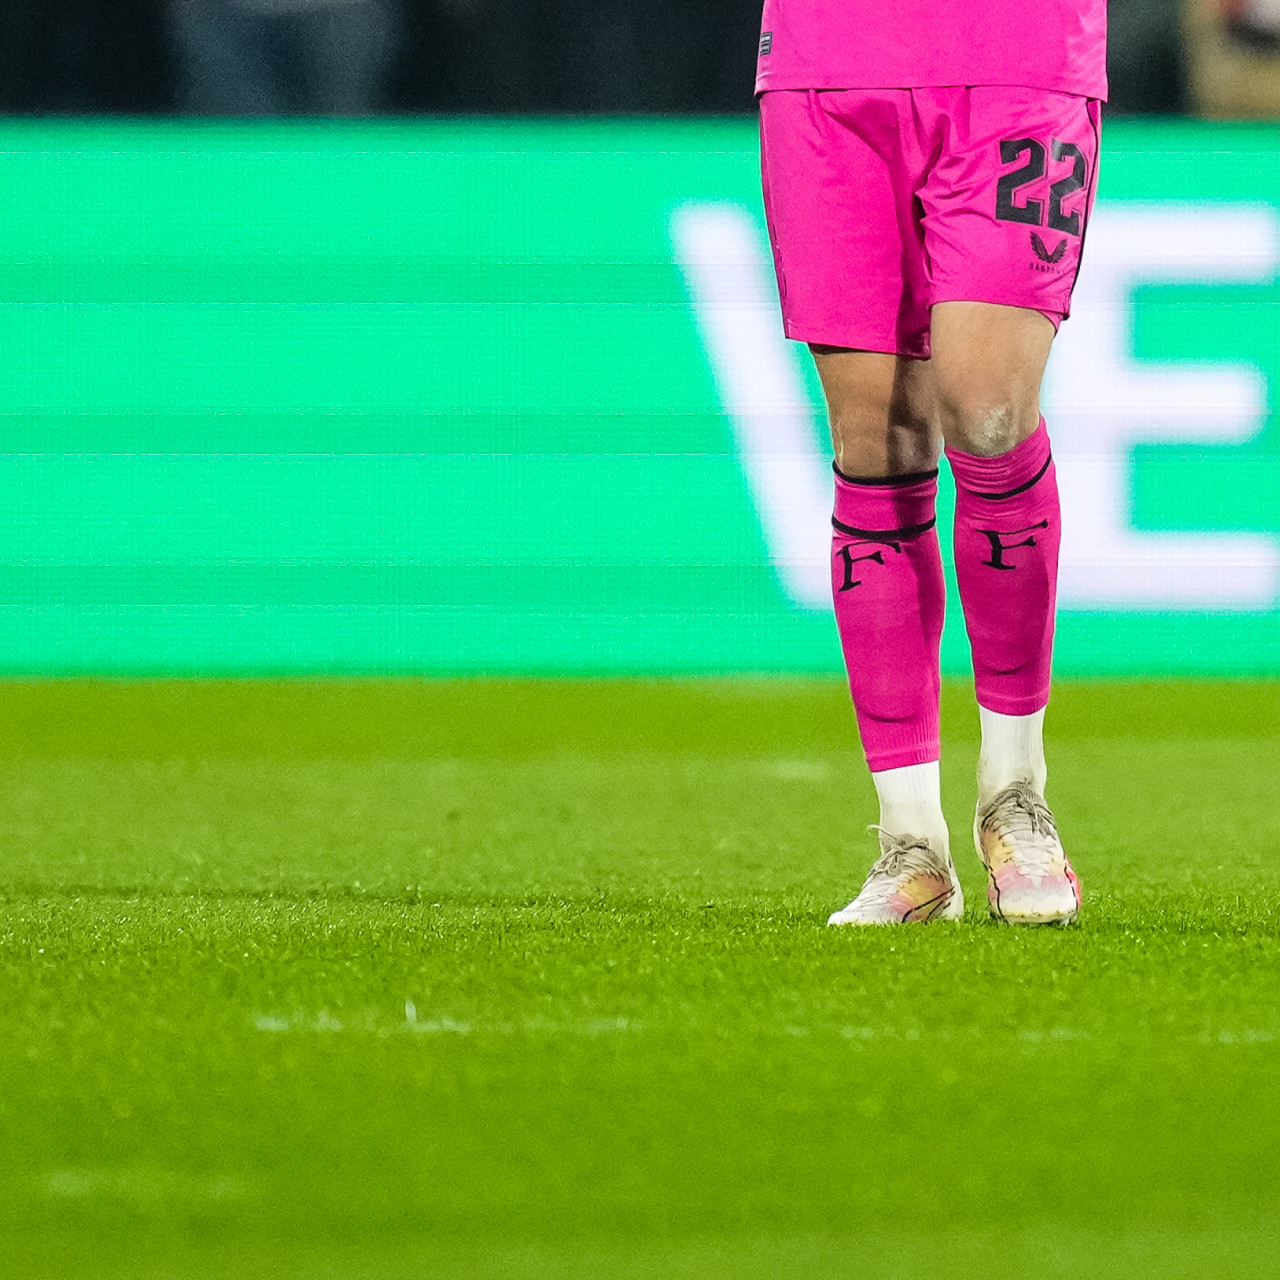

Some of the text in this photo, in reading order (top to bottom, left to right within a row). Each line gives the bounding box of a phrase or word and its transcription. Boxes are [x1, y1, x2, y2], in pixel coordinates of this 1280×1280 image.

[995, 137, 1087, 236] 22
[835, 541, 901, 592] F
[976, 519, 1049, 570] F
